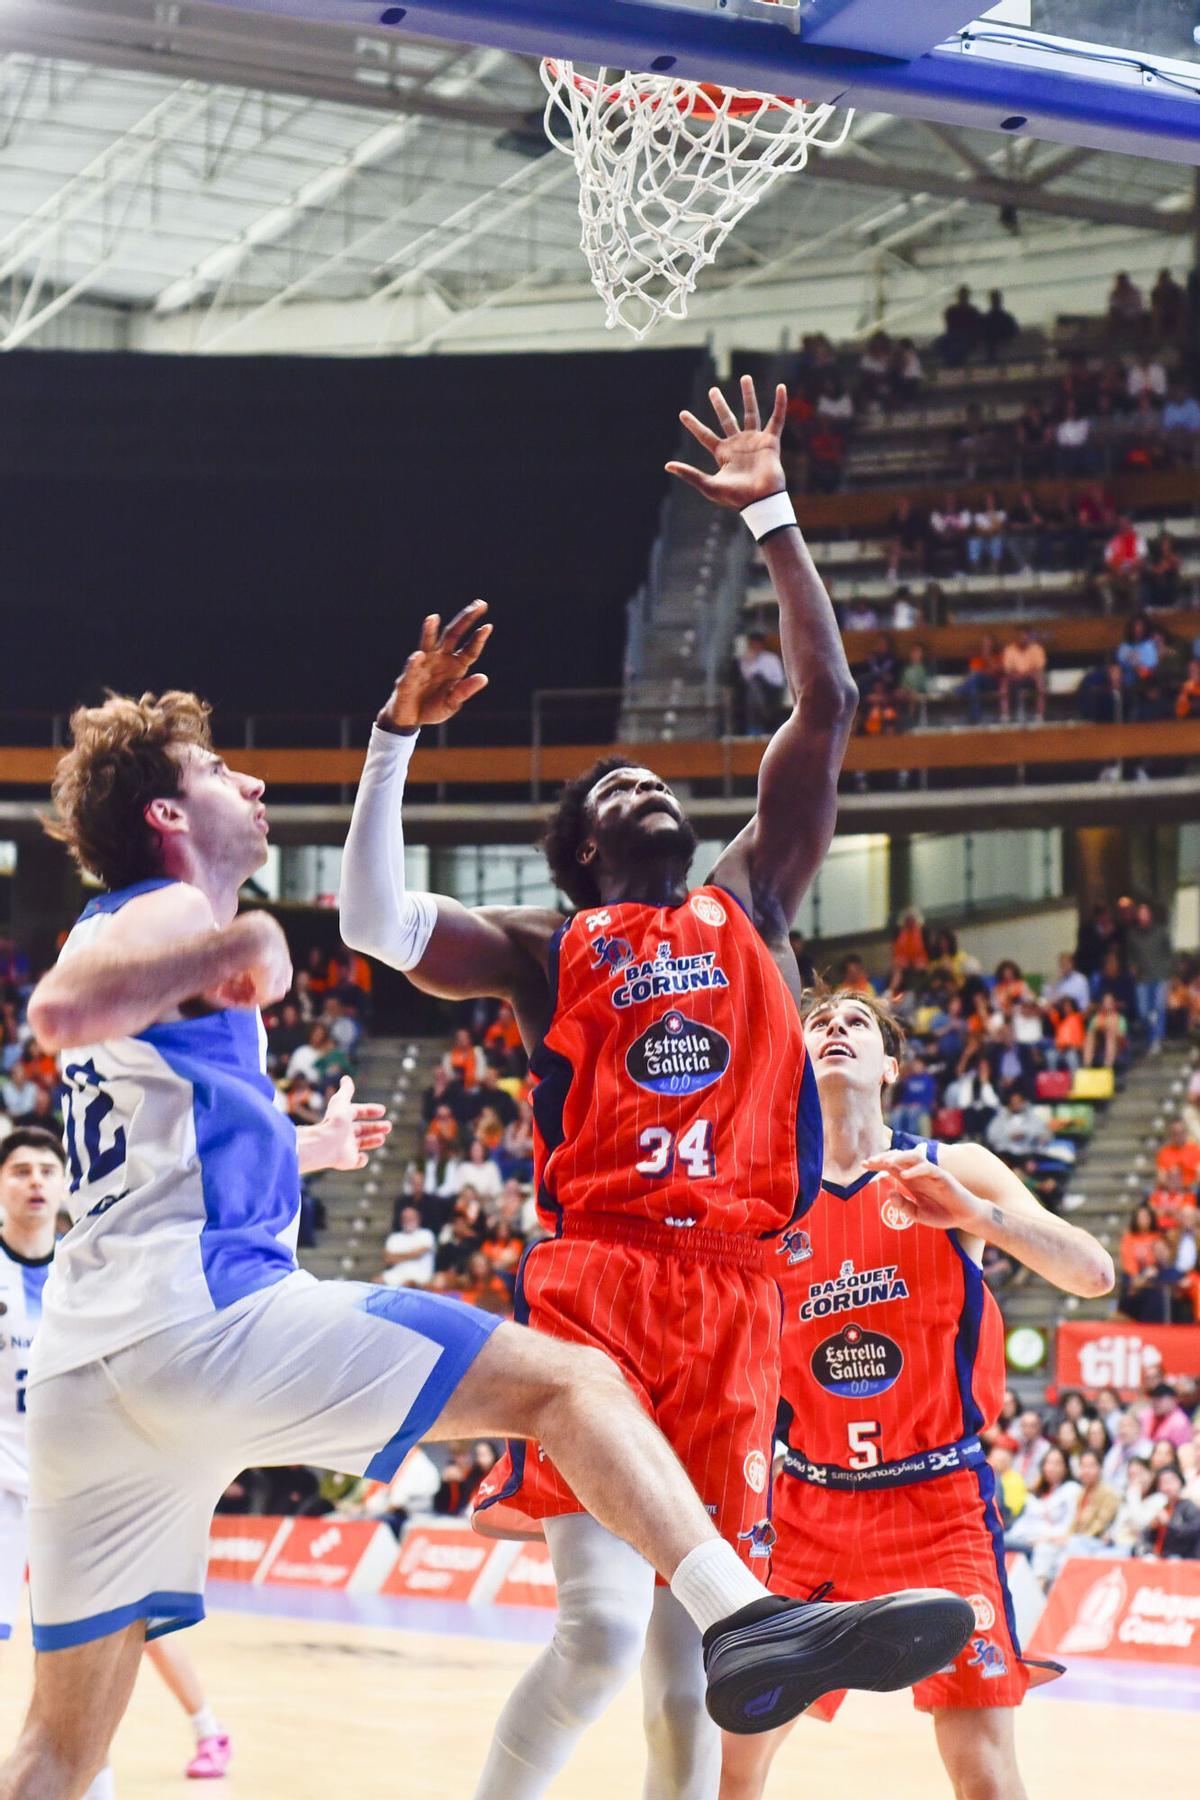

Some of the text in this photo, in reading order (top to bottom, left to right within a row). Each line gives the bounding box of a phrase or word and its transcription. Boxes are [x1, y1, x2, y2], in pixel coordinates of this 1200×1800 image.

[625, 953, 715, 981] BASQUET
[643, 1034, 711, 1057] Estrella
[646, 1052, 711, 1075] Galicia
[635, 1119, 715, 1179] 34
[809, 1267, 897, 1298] BASQUET
[825, 1343, 886, 1363] Estrella
[829, 1360, 886, 1380] Galicia
[848, 1421, 880, 1470] 5
